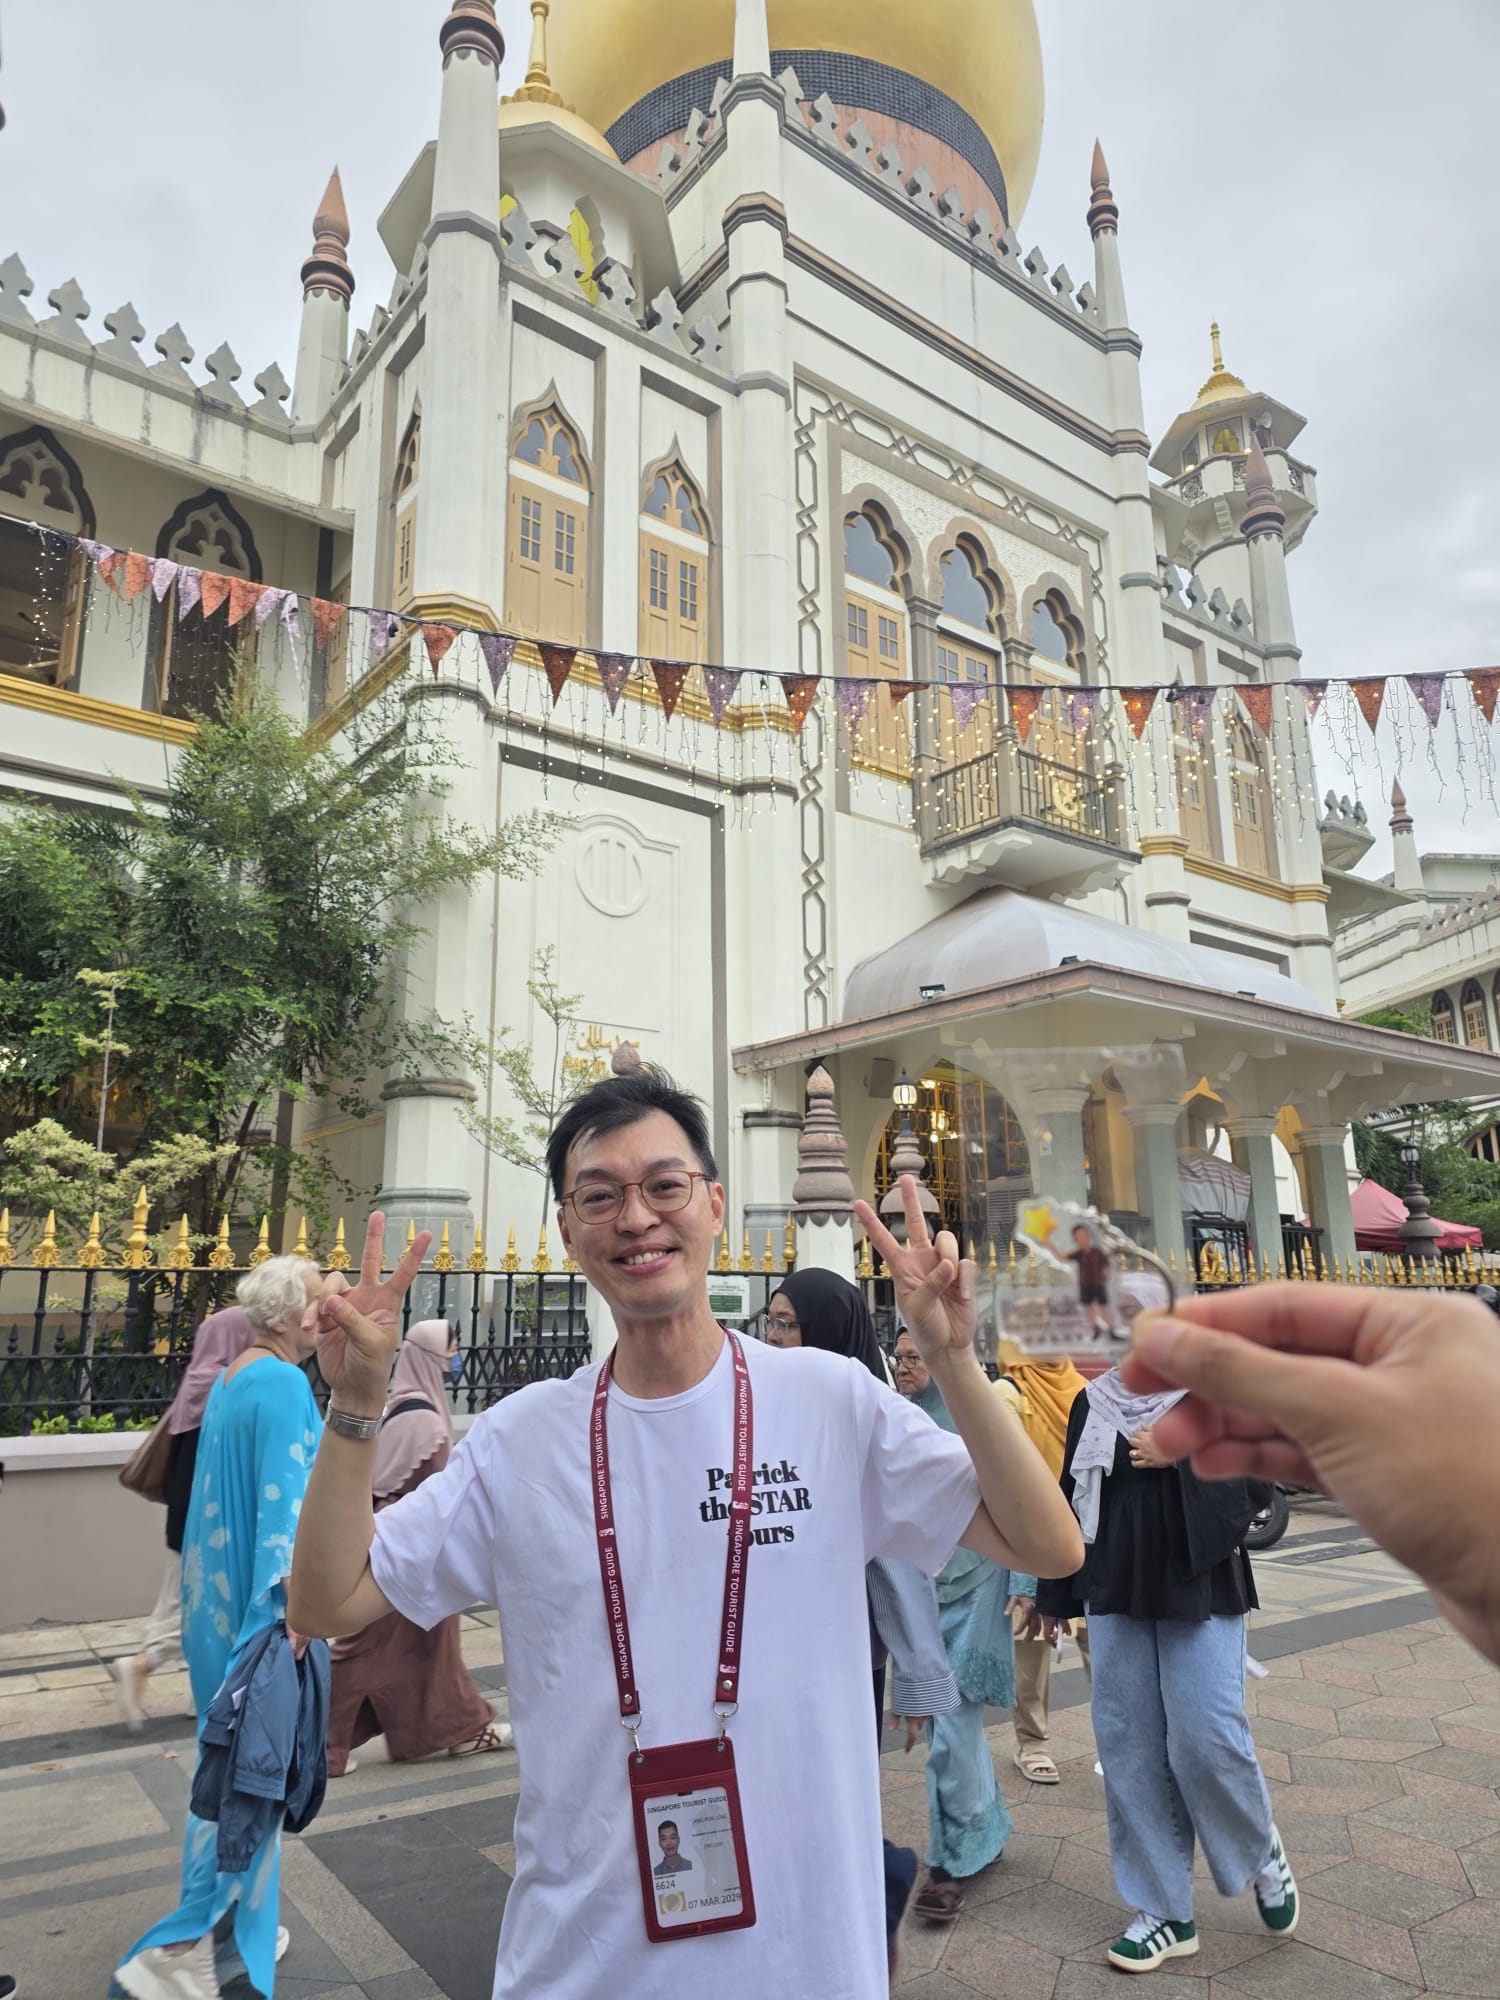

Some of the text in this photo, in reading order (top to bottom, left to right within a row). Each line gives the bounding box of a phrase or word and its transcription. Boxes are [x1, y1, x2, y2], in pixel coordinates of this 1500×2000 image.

[595, 1433, 604, 1469] TOURIST
[737, 1378, 748, 1492] SINGAPORE TOURIST GUIDE
[706, 1460, 800, 1491] Parick
[596, 1469, 609, 1520] SINGAPORE
[750, 1488, 812, 1515] STAR
[725, 1519, 744, 1653] SINGAPORE TOURIST GUIDE
[605, 1546, 630, 1680] SINGAPORE TOURIST GUIDE
[647, 1803, 681, 1814] SINGAPORE
[682, 1799, 707, 1808] TOURIST
[655, 1880, 676, 1891] 6624
[688, 1901, 698, 1910] 07
[701, 1897, 720, 1907] MAR
